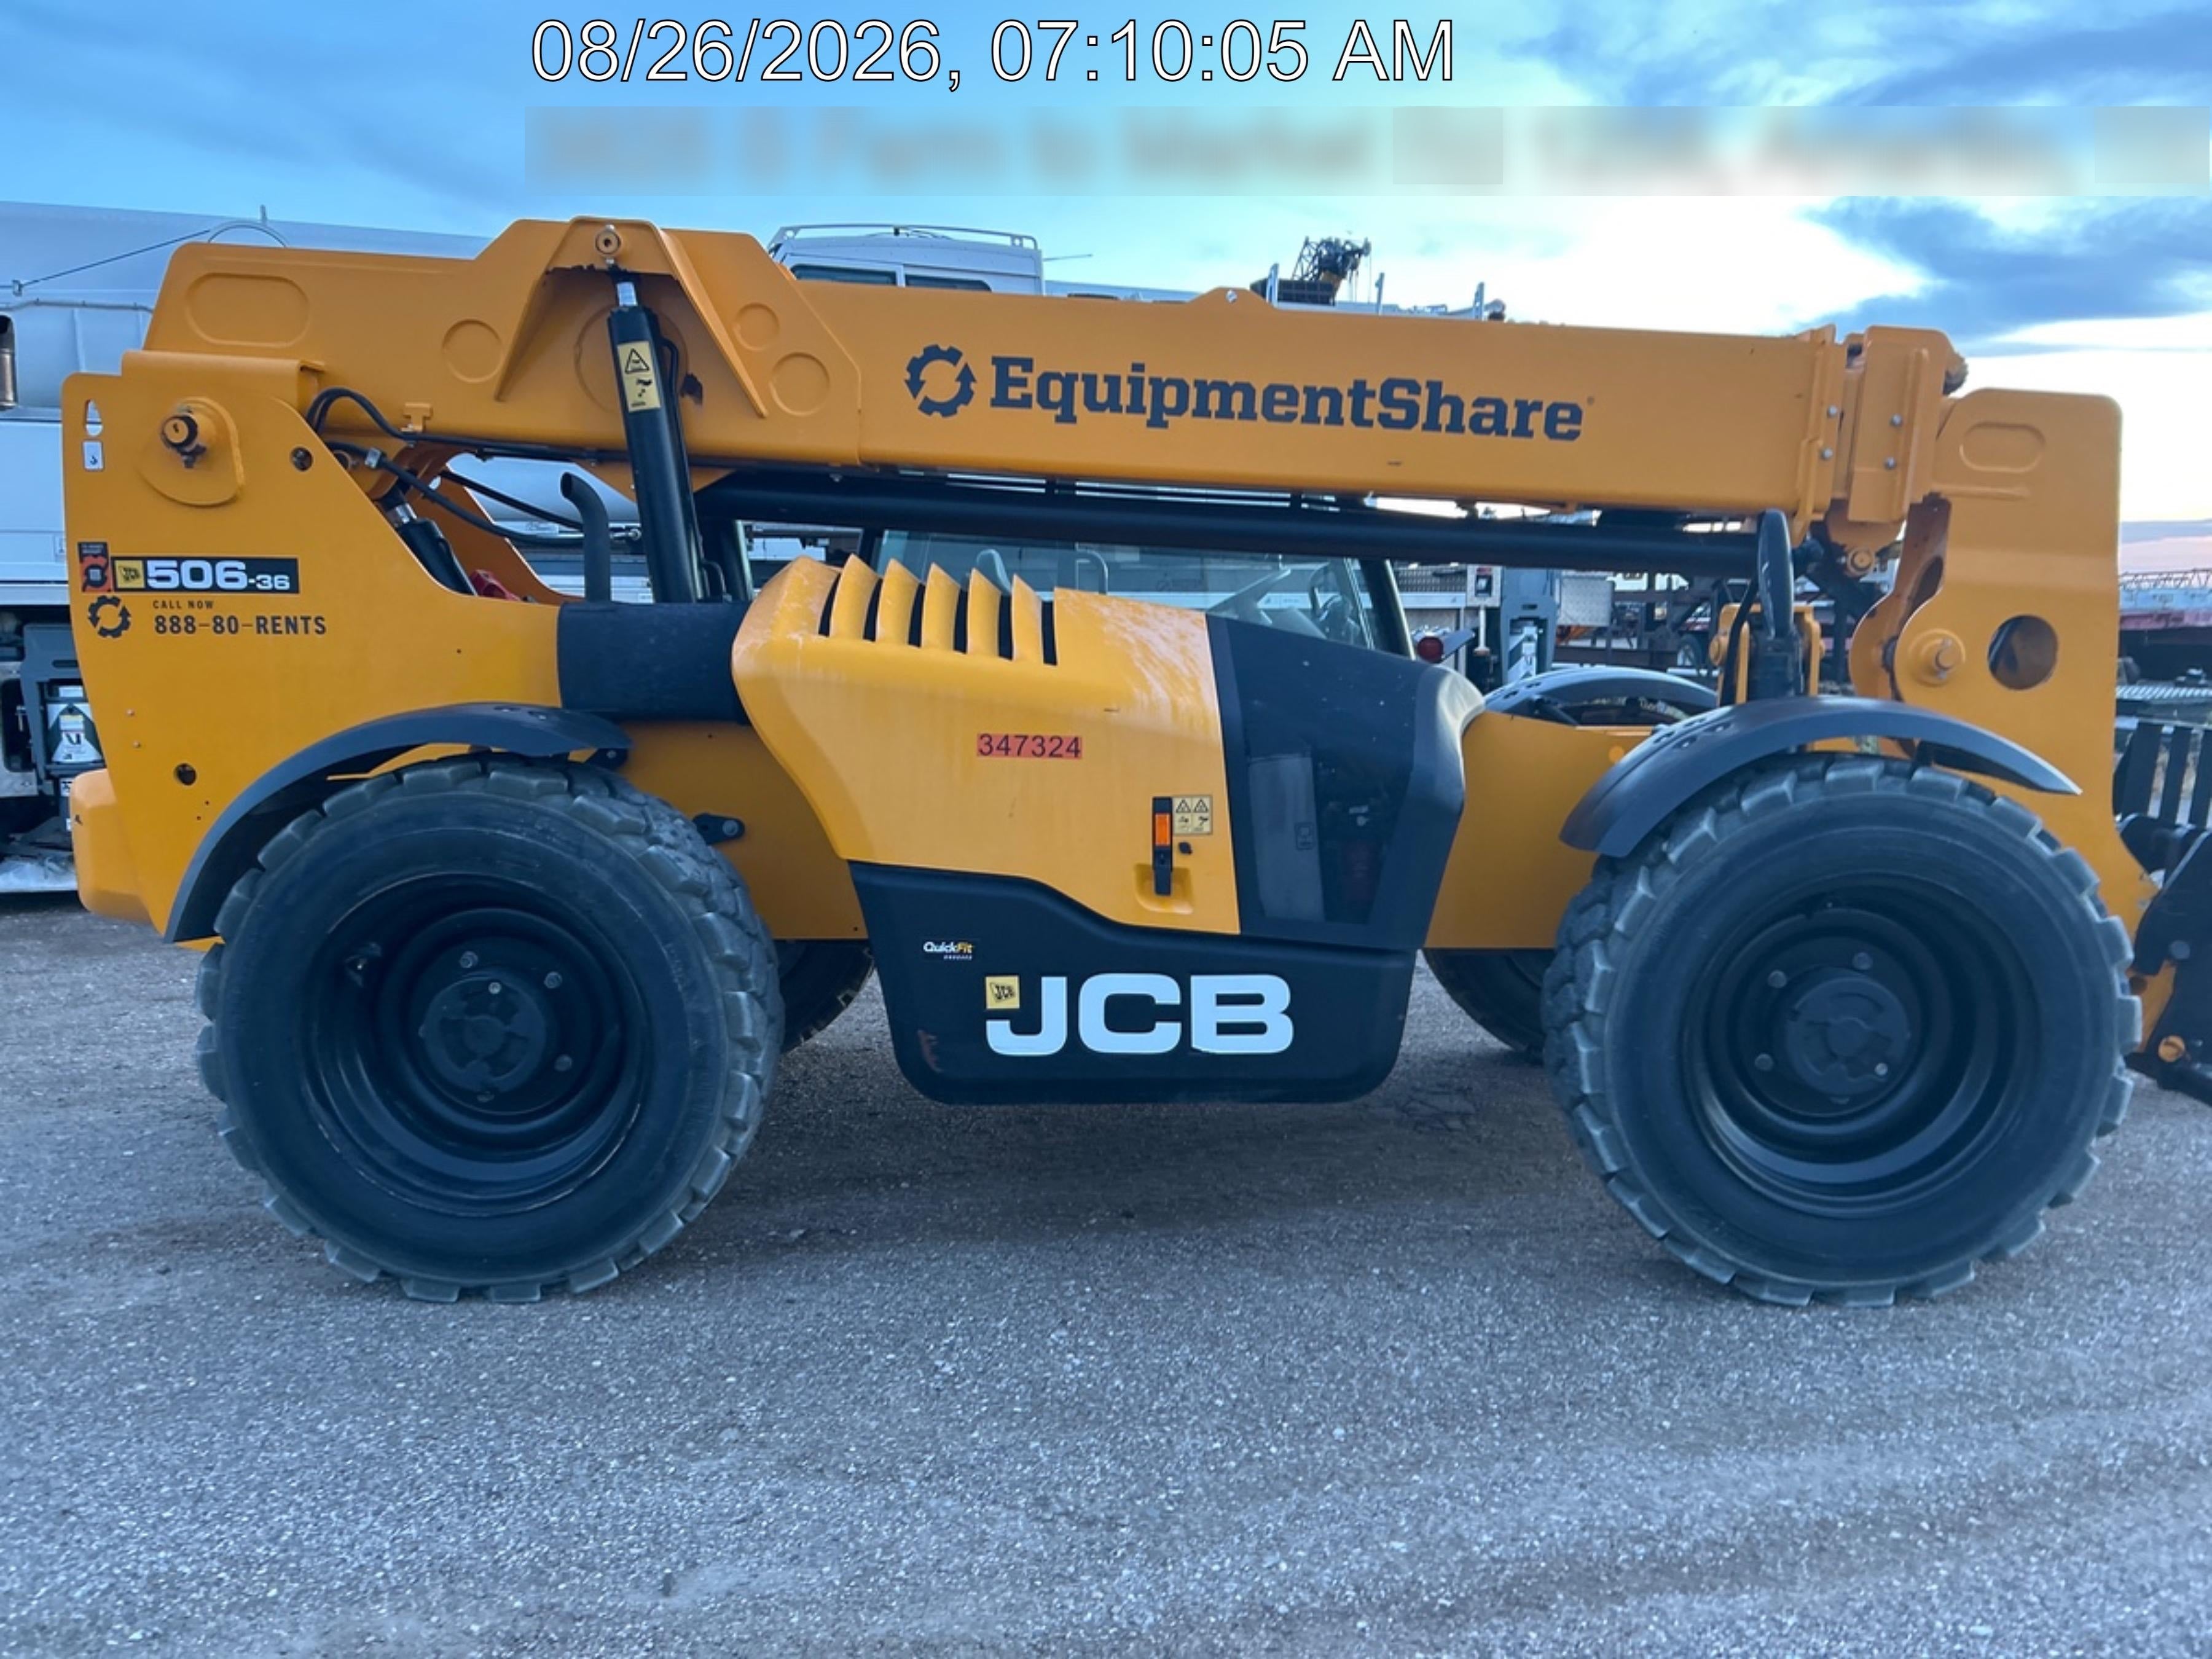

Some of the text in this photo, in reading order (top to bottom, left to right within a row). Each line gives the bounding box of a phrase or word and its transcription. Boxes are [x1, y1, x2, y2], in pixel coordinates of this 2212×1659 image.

[990, 356, 1583, 441] EquipmentShare
[153, 600, 214, 609] CALL NOW
[155, 615, 326, 635] 888-80-RENTS
[979, 734, 1081, 758] 347324
[923, 941, 973, 954] QuickFit
[986, 972, 1294, 1056] JCB
